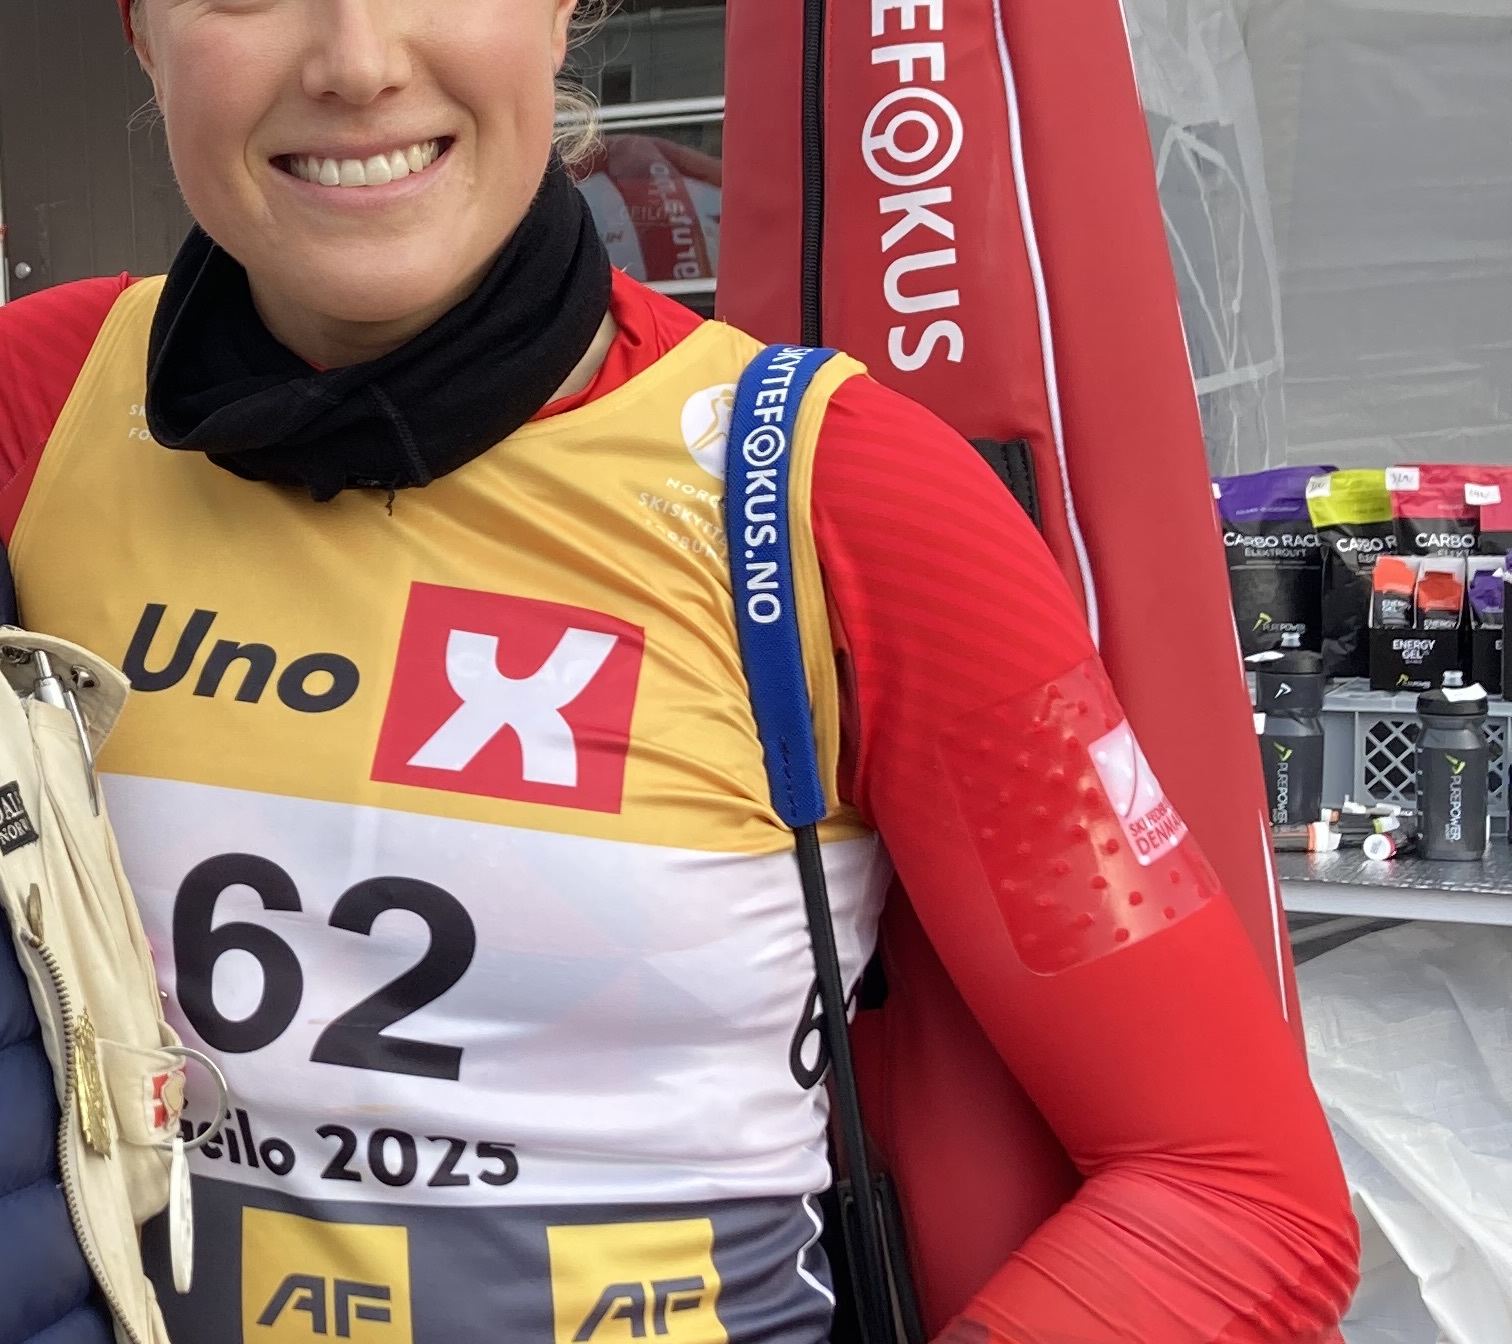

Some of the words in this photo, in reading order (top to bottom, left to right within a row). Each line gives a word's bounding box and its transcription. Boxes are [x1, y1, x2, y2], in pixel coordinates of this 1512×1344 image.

[1223, 531, 1279, 549] CARBO
[1415, 532, 1476, 549] CARBO
[121, 602, 362, 714] Uno
[1392, 638, 1437, 651] ENERGY
[172, 851, 477, 1082] 62
[179, 1099, 296, 1176] eilo
[314, 1122, 520, 1188] 2025
[255, 1272, 392, 1339] AF
[570, 1274, 706, 1344] AF
